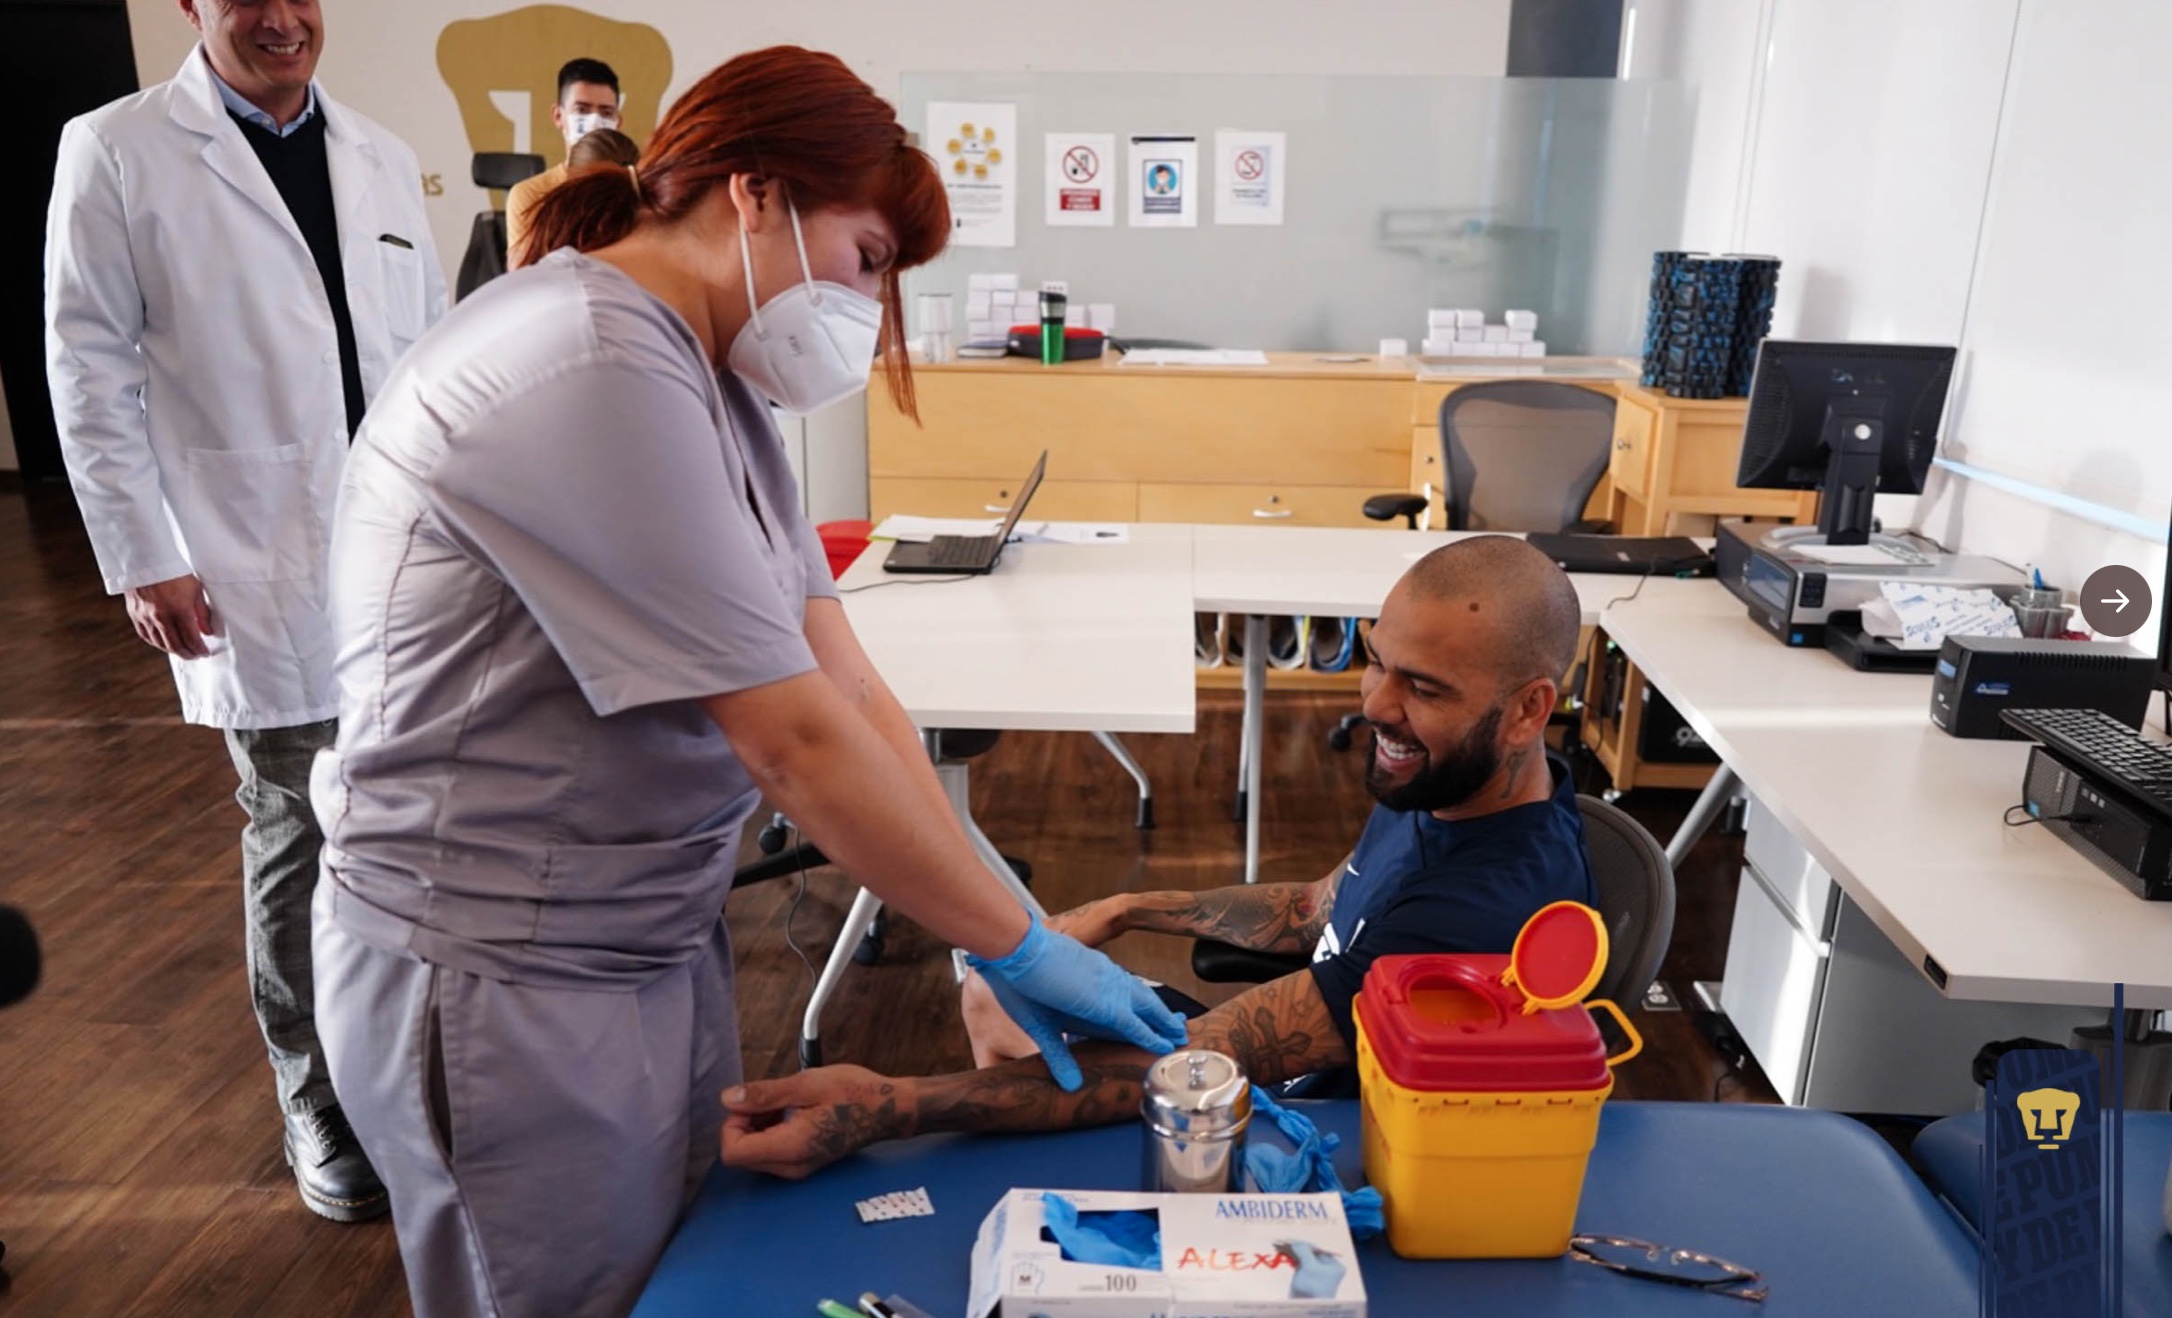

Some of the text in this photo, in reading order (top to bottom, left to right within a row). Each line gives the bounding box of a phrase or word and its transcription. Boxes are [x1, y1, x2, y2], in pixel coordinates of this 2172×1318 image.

[1215, 1199, 1329, 1220] AMBIDERM
[1178, 1246, 1299, 1271] ALEXA
[1105, 1274, 1137, 1292] 100
